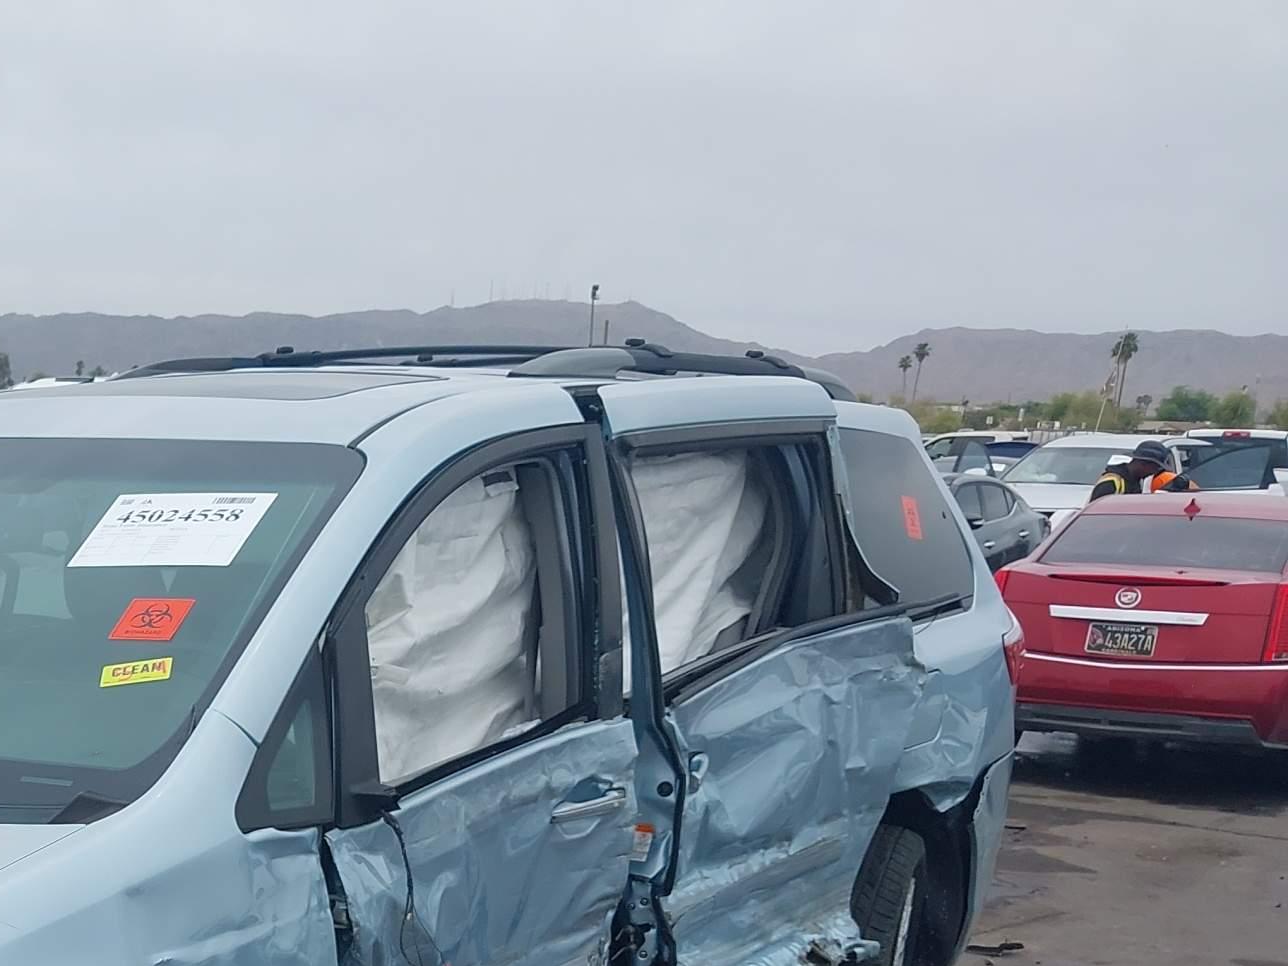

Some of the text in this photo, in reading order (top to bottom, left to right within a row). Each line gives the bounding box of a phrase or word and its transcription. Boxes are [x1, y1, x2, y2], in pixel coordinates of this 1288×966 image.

[117, 508, 244, 523] 45024558
[1104, 632, 1153, 651] 43A27A
[112, 661, 163, 678] CLEAN
